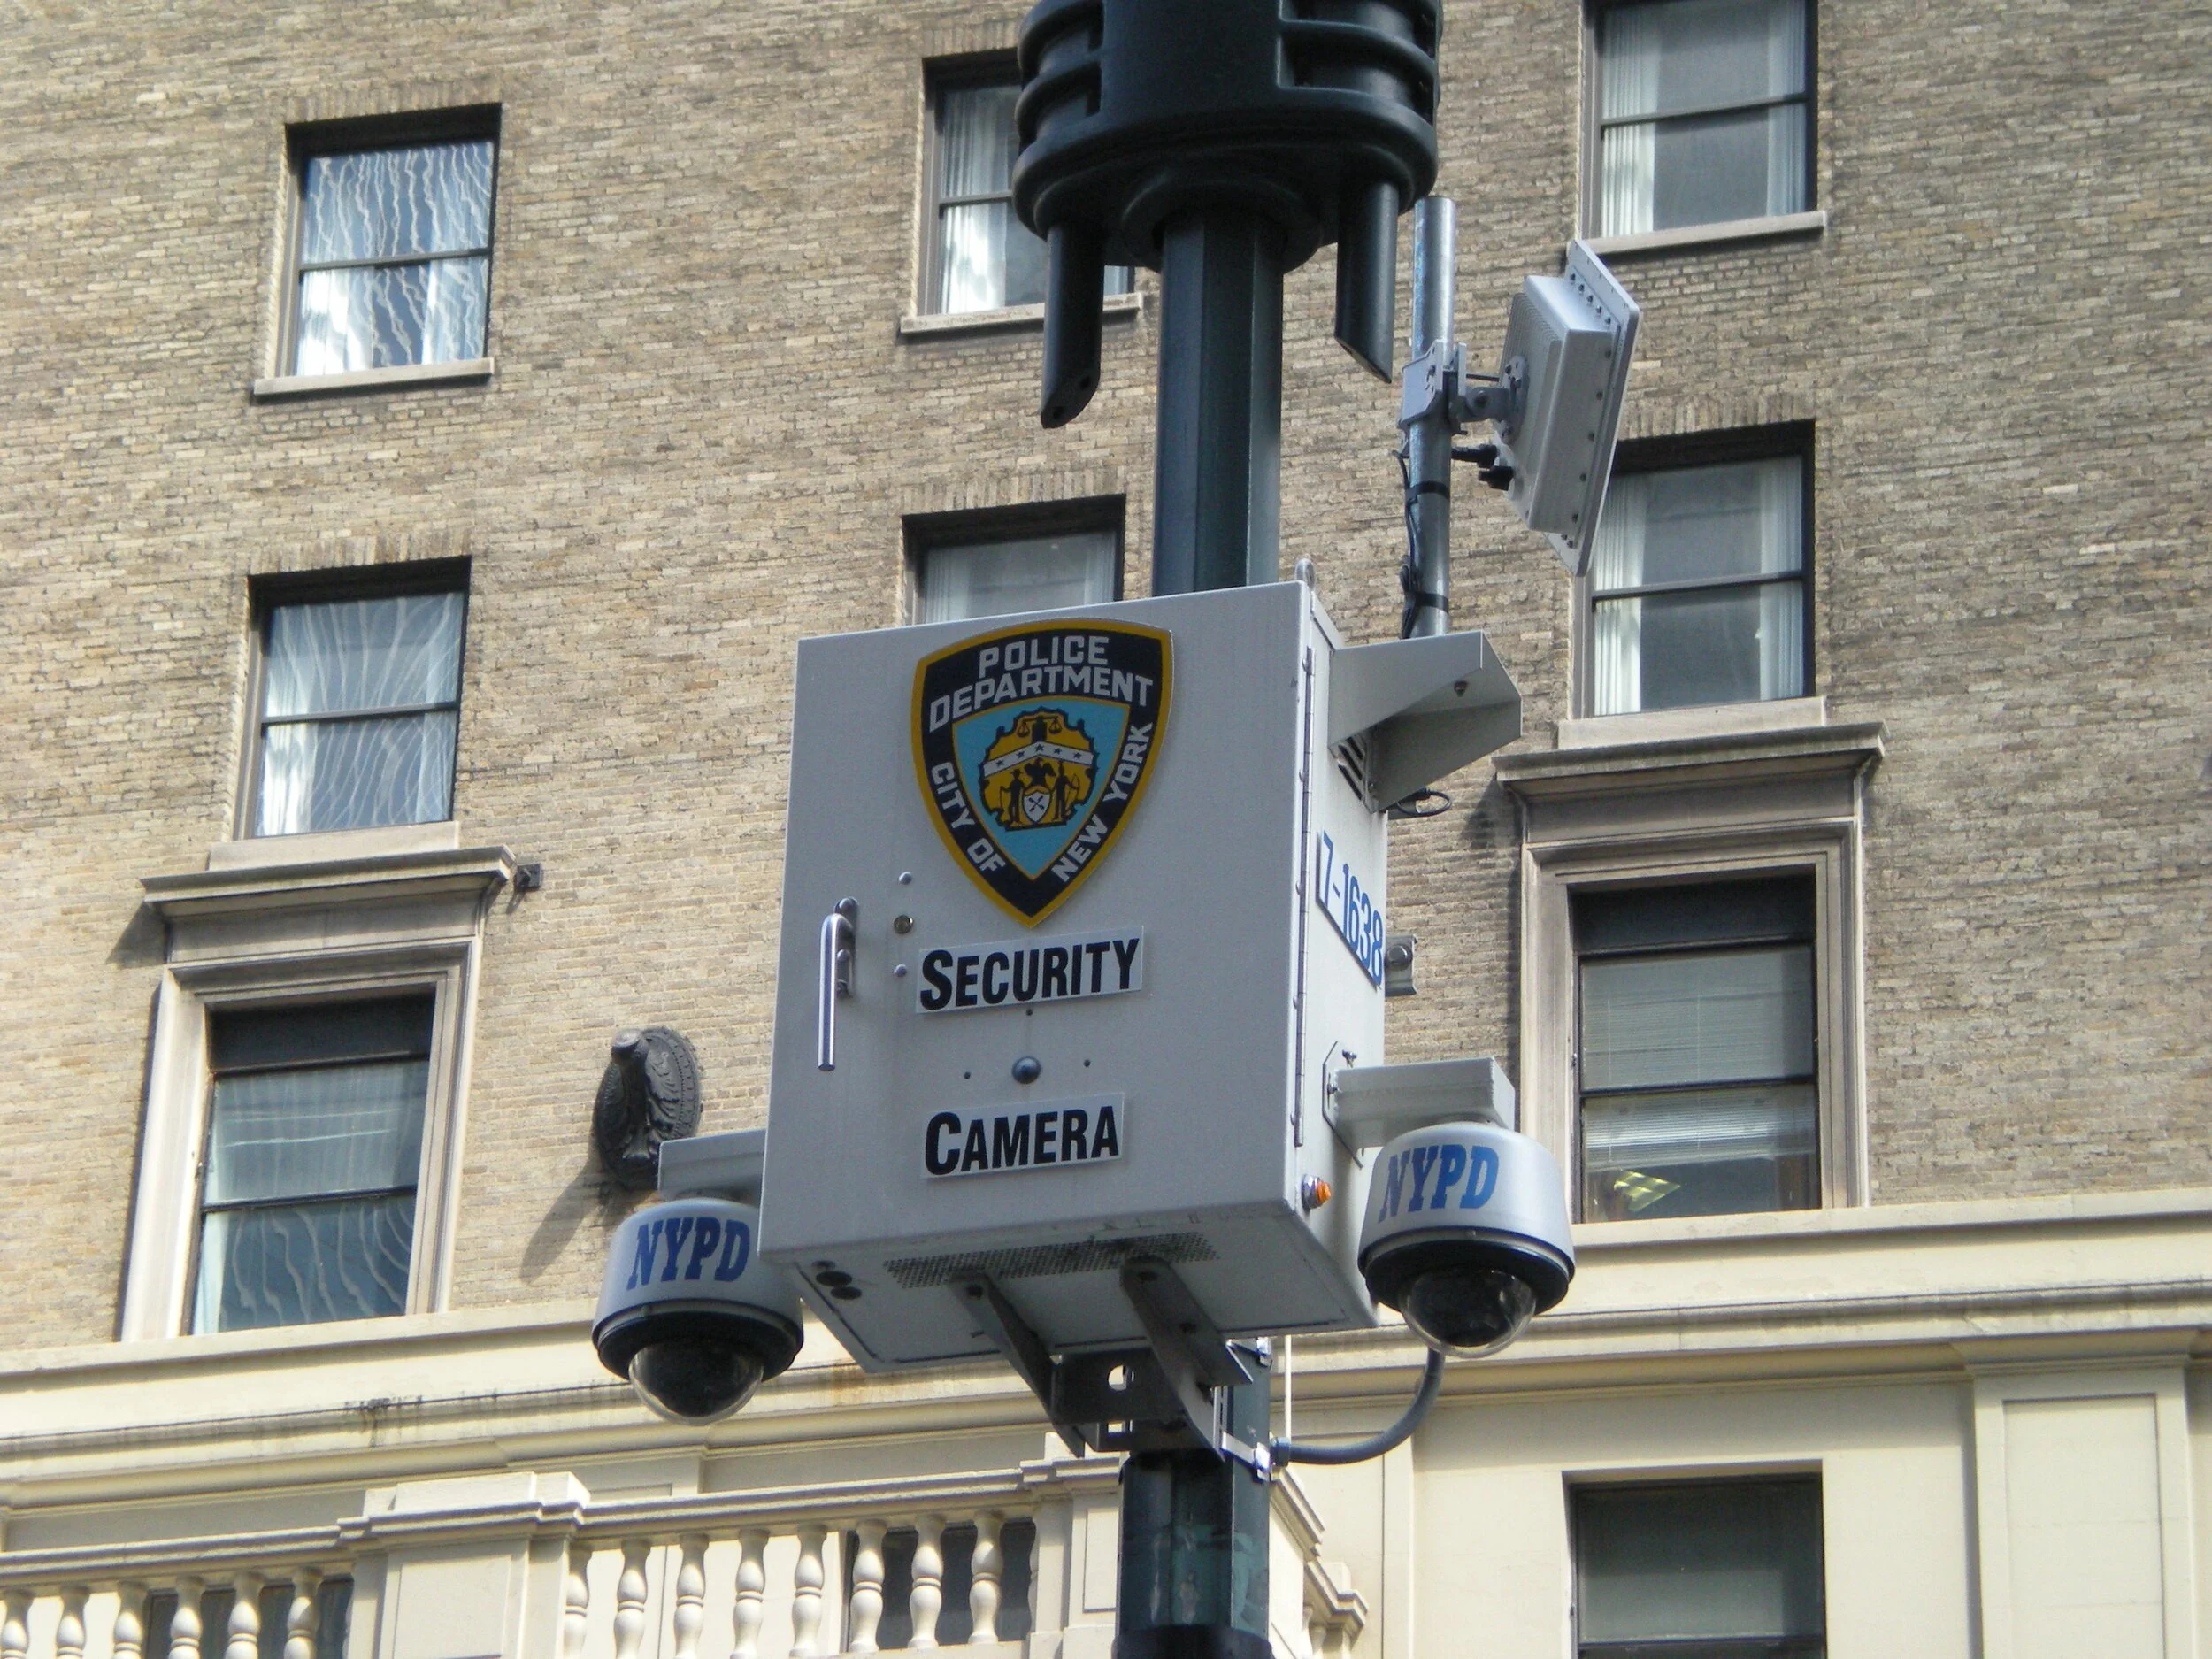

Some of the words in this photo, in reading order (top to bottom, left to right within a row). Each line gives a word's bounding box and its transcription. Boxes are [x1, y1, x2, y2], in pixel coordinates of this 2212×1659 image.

[979, 636, 1110, 678] POLICE
[929, 665, 1153, 733] DEPARTMENT
[931, 762, 975, 830] CITY
[967, 837, 1005, 872] OF
[1051, 814, 1109, 883] NEW
[1102, 722, 1154, 803] YORK
[1323, 830, 1384, 987] 7-1638
[919, 938, 1140, 1010] SECURITY
[925, 1106, 1119, 1176] CAMERA
[1378, 1144, 1500, 1224] NYPD
[626, 1217, 750, 1290] NYPD
